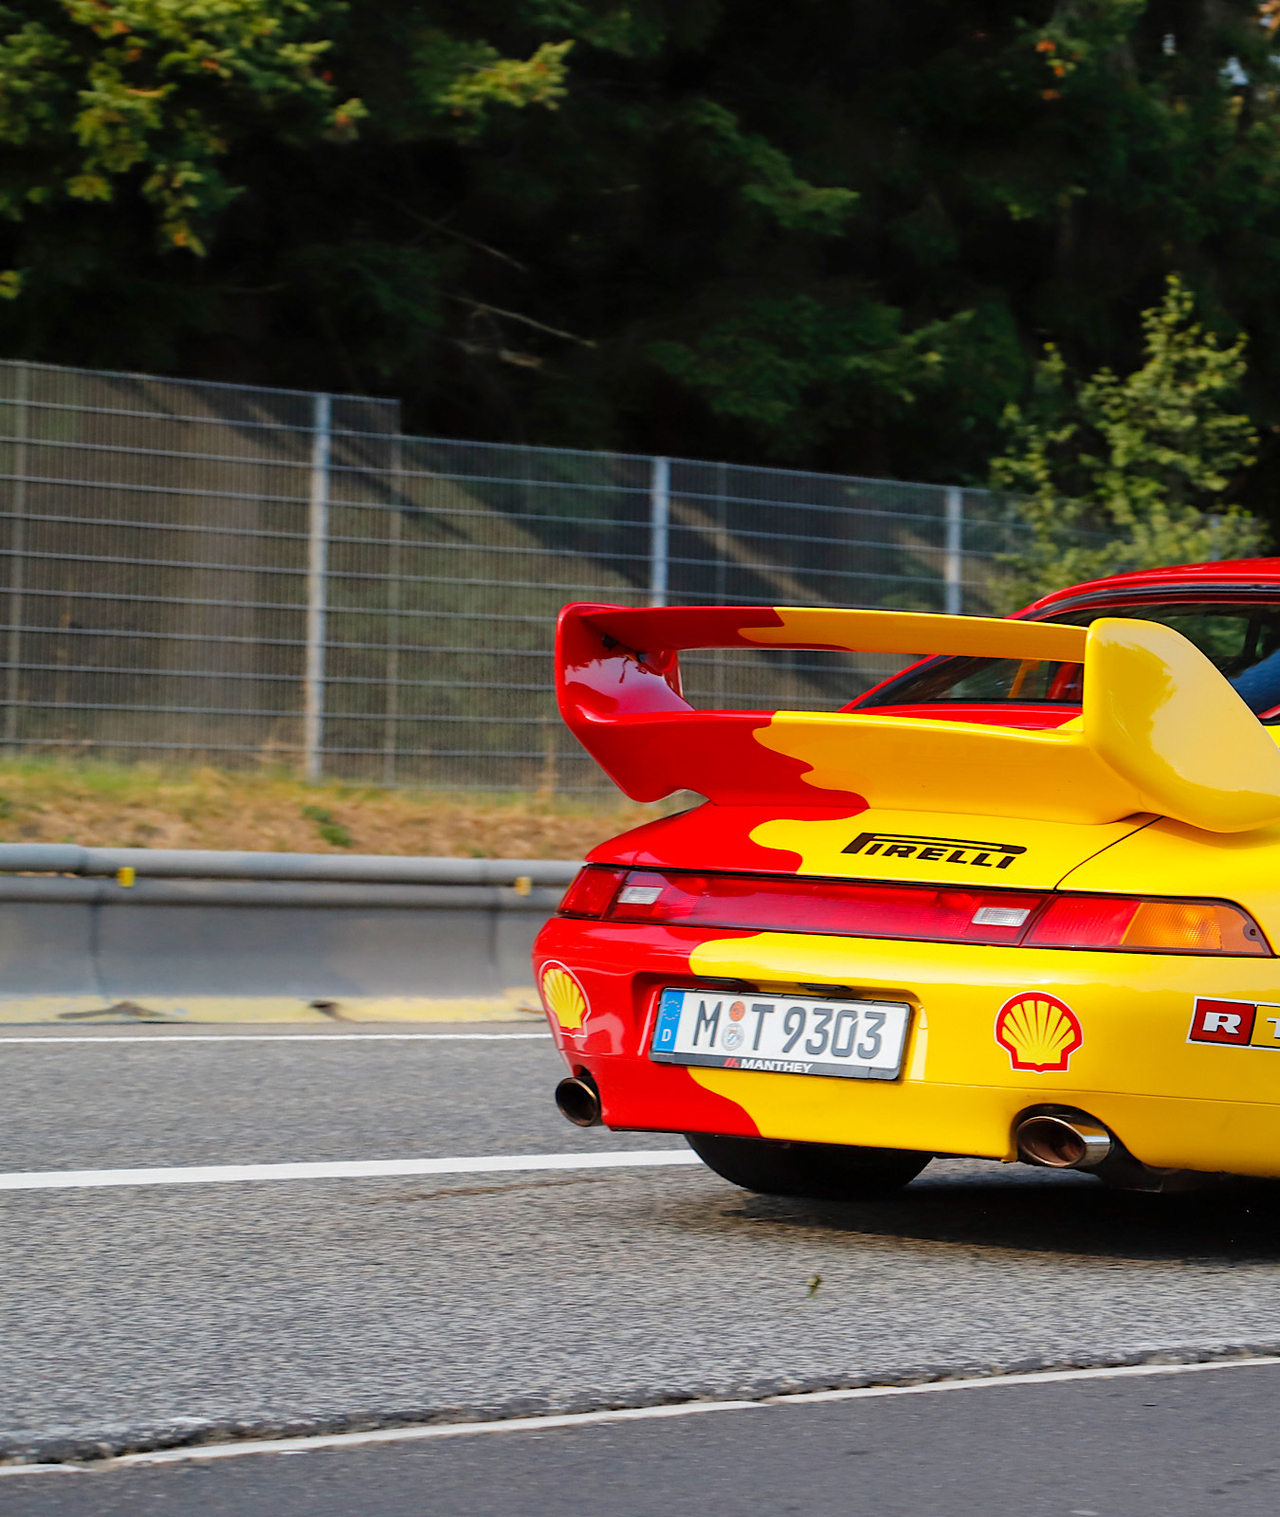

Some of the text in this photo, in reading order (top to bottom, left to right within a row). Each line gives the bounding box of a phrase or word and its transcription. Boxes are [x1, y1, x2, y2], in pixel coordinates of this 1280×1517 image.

[840, 832, 1027, 869] PIRELLI
[661, 1028, 671, 1042] D
[693, 1000, 886, 1060] M T 9303
[739, 1058, 813, 1073] MANTHEY
